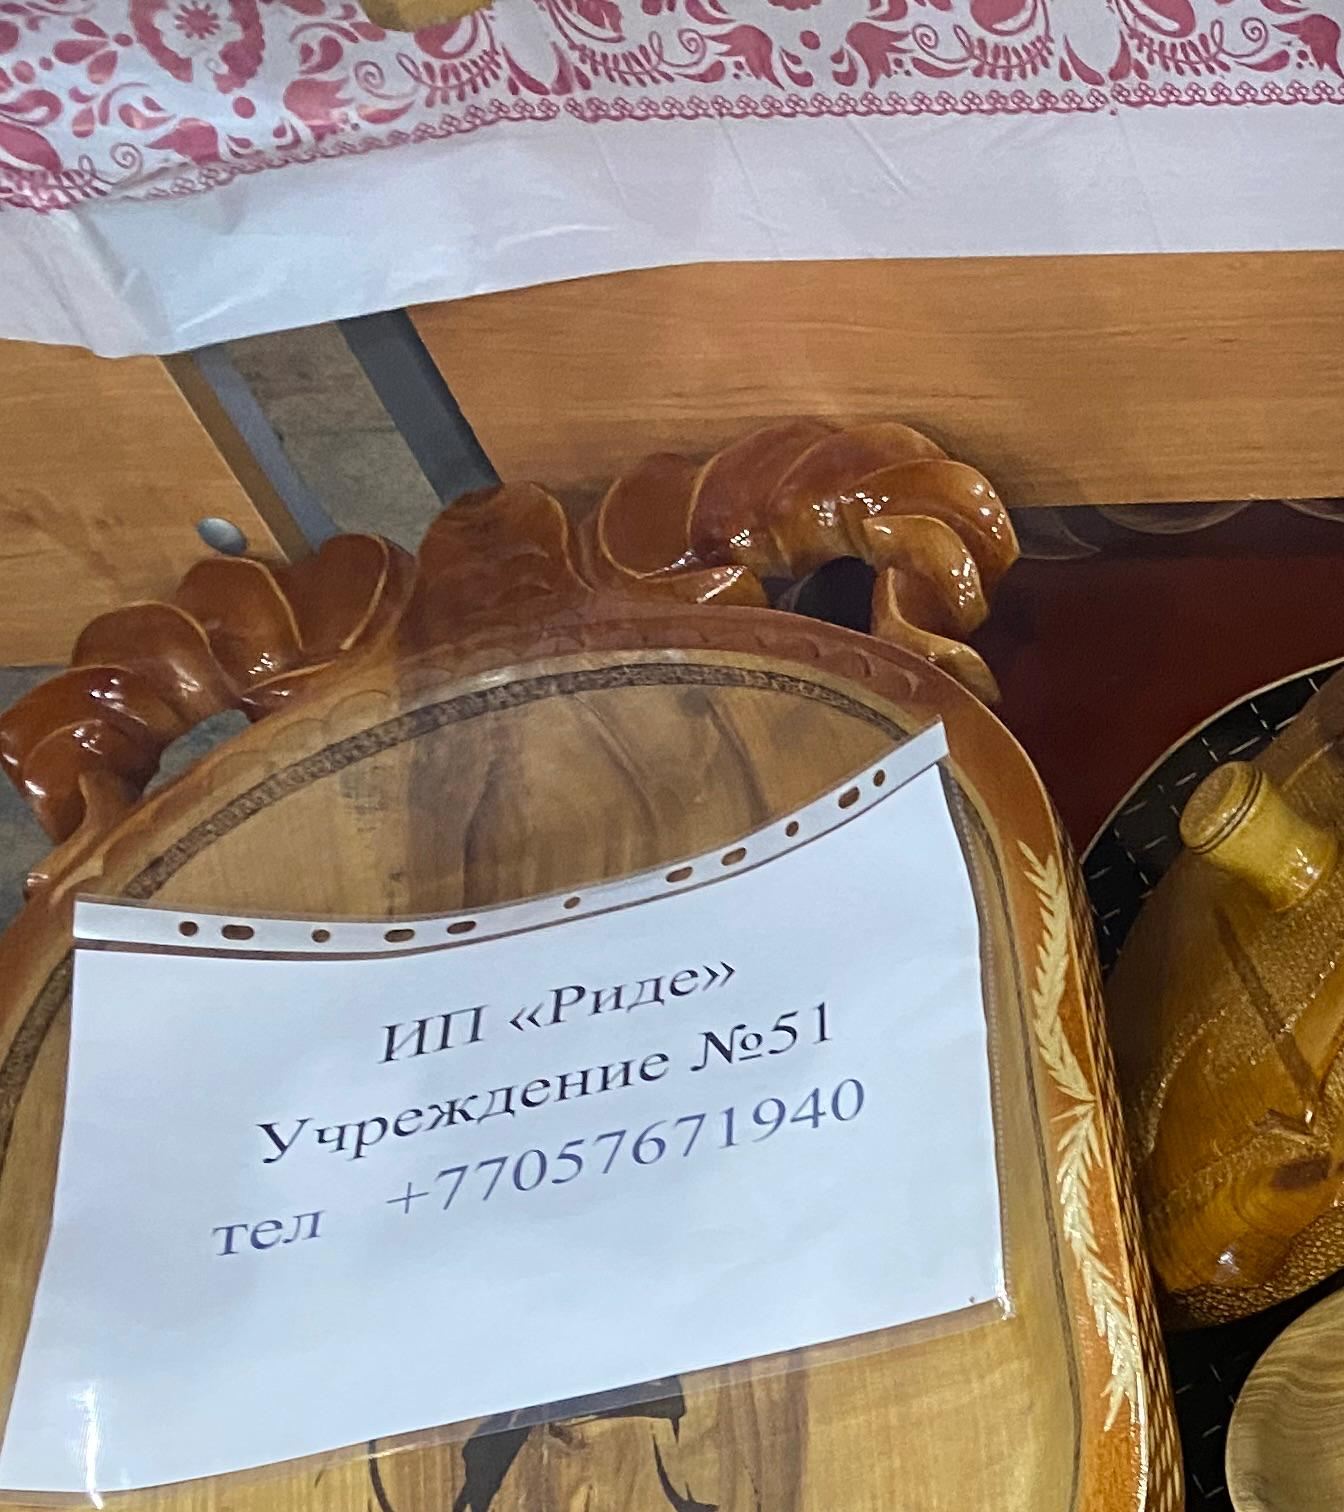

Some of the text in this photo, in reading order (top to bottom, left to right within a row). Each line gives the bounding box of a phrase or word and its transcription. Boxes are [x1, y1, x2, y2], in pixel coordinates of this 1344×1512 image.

[257, 1003, 832, 1166] Учреждение №51
[379, 958, 738, 1067] ИП «Риде»
[212, 1077, 865, 1257] тел +77057671940
